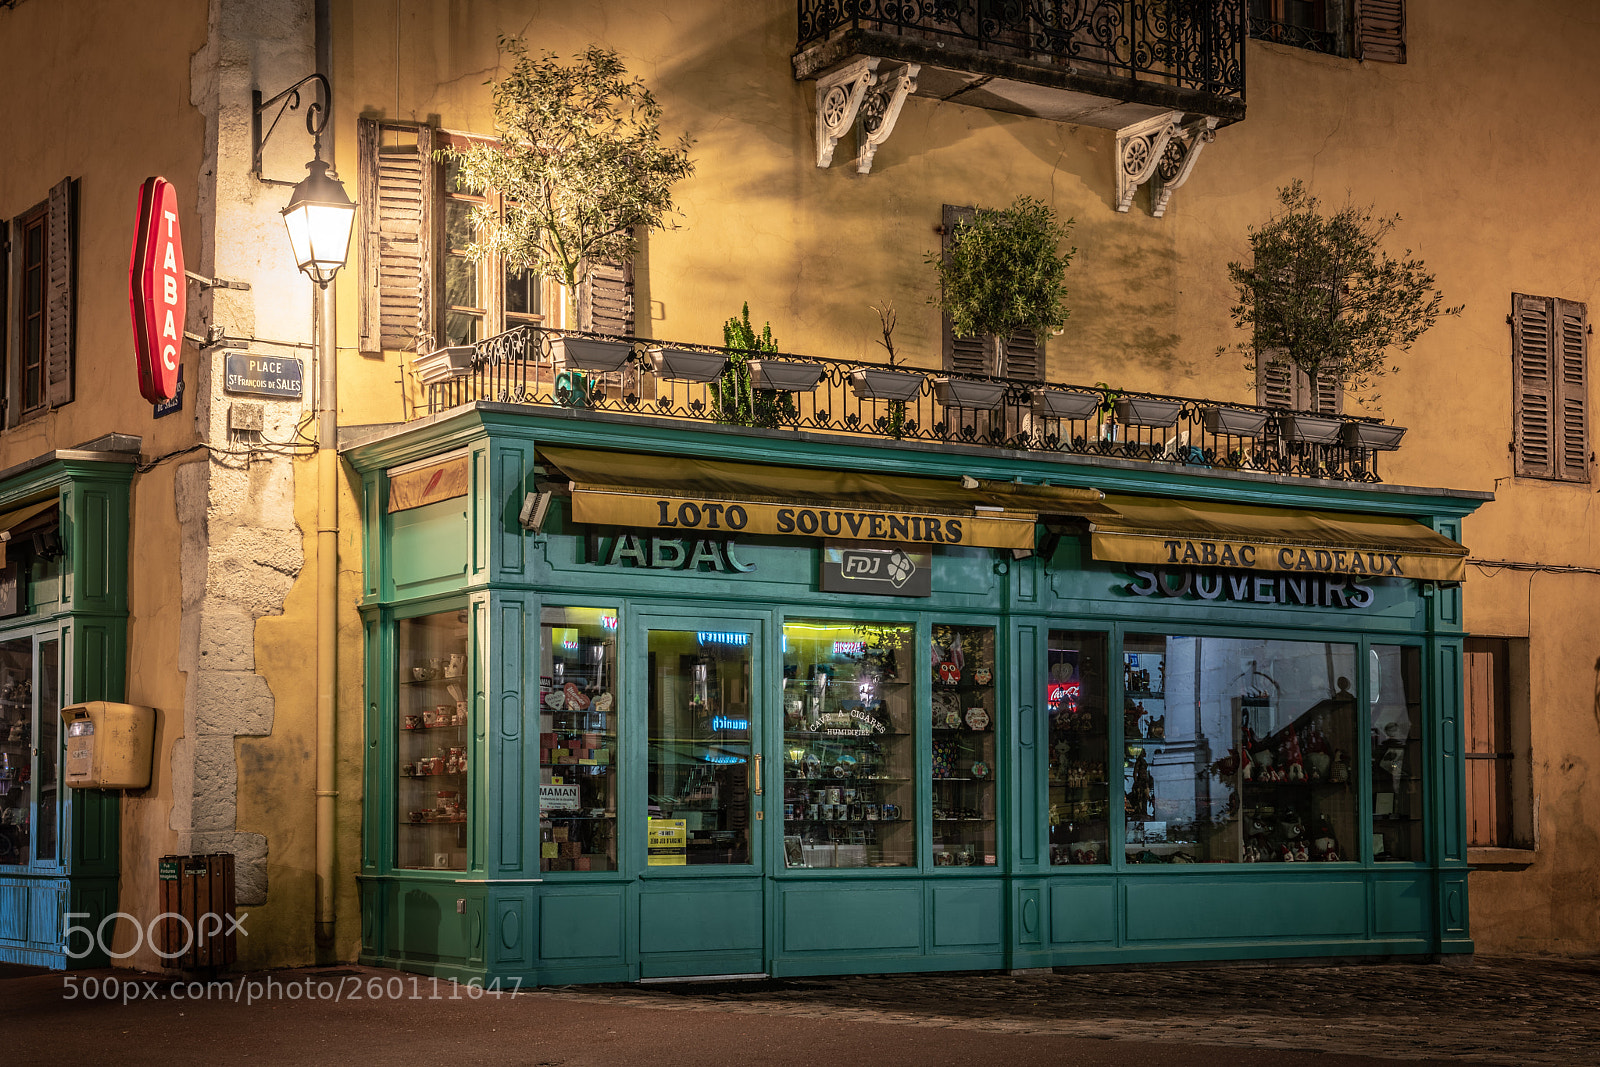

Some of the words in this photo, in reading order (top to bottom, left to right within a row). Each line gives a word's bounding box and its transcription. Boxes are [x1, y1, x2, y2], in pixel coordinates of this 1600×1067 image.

[163, 210, 178, 371] TABAC
[249, 360, 282, 374] PLACE
[268, 380, 276, 389] DE
[276, 378, 301, 391] SALES
[656, 501, 748, 530] LOTO
[776, 508, 963, 543] SOUVENIRS
[846, 555, 881, 574] FDJ
[1163, 540, 1256, 567] TABAC
[1277, 547, 1404, 576] CADEAUX
[810, 713, 832, 732] CAVE
[838, 709, 844, 718] A
[850, 709, 886, 734] CIGARES
[539, 787, 577, 797] MAMAN
